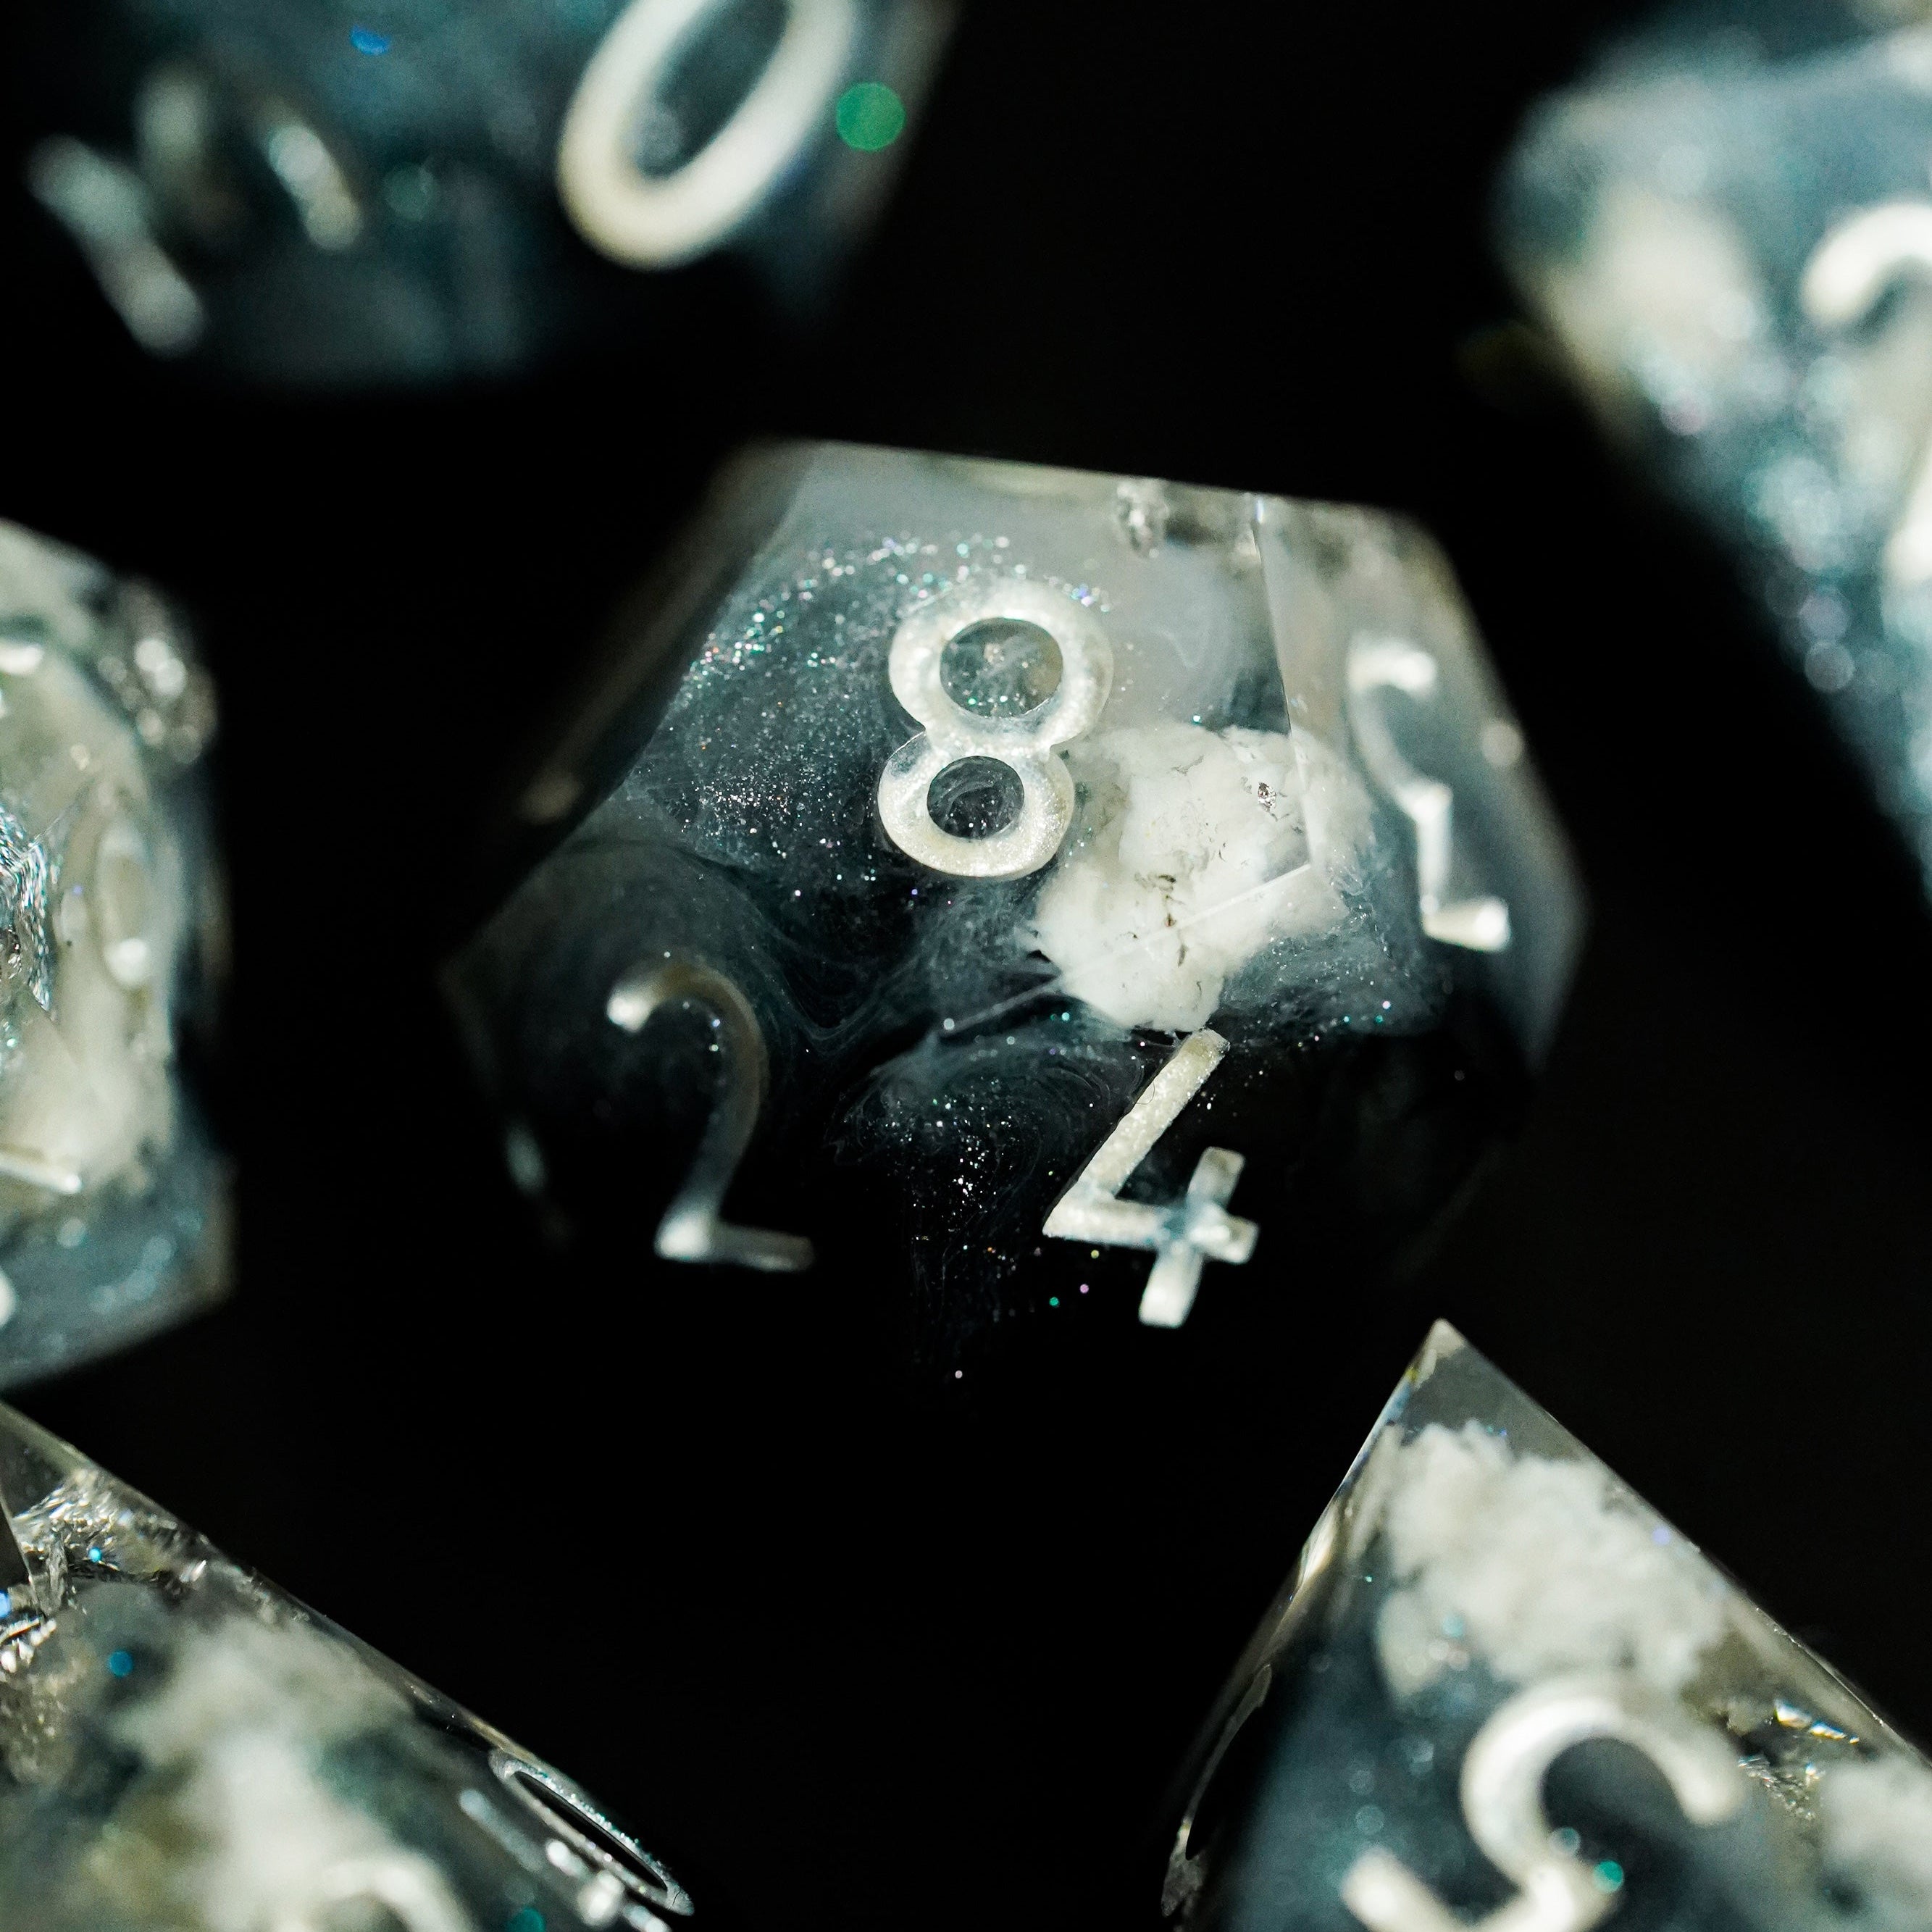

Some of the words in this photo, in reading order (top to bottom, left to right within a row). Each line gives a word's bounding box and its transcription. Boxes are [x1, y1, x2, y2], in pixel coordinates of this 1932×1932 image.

[878, 579, 1114, 878] 8
[607, 955, 814, 1273] 2
[1042, 1027, 1259, 1327] 4
